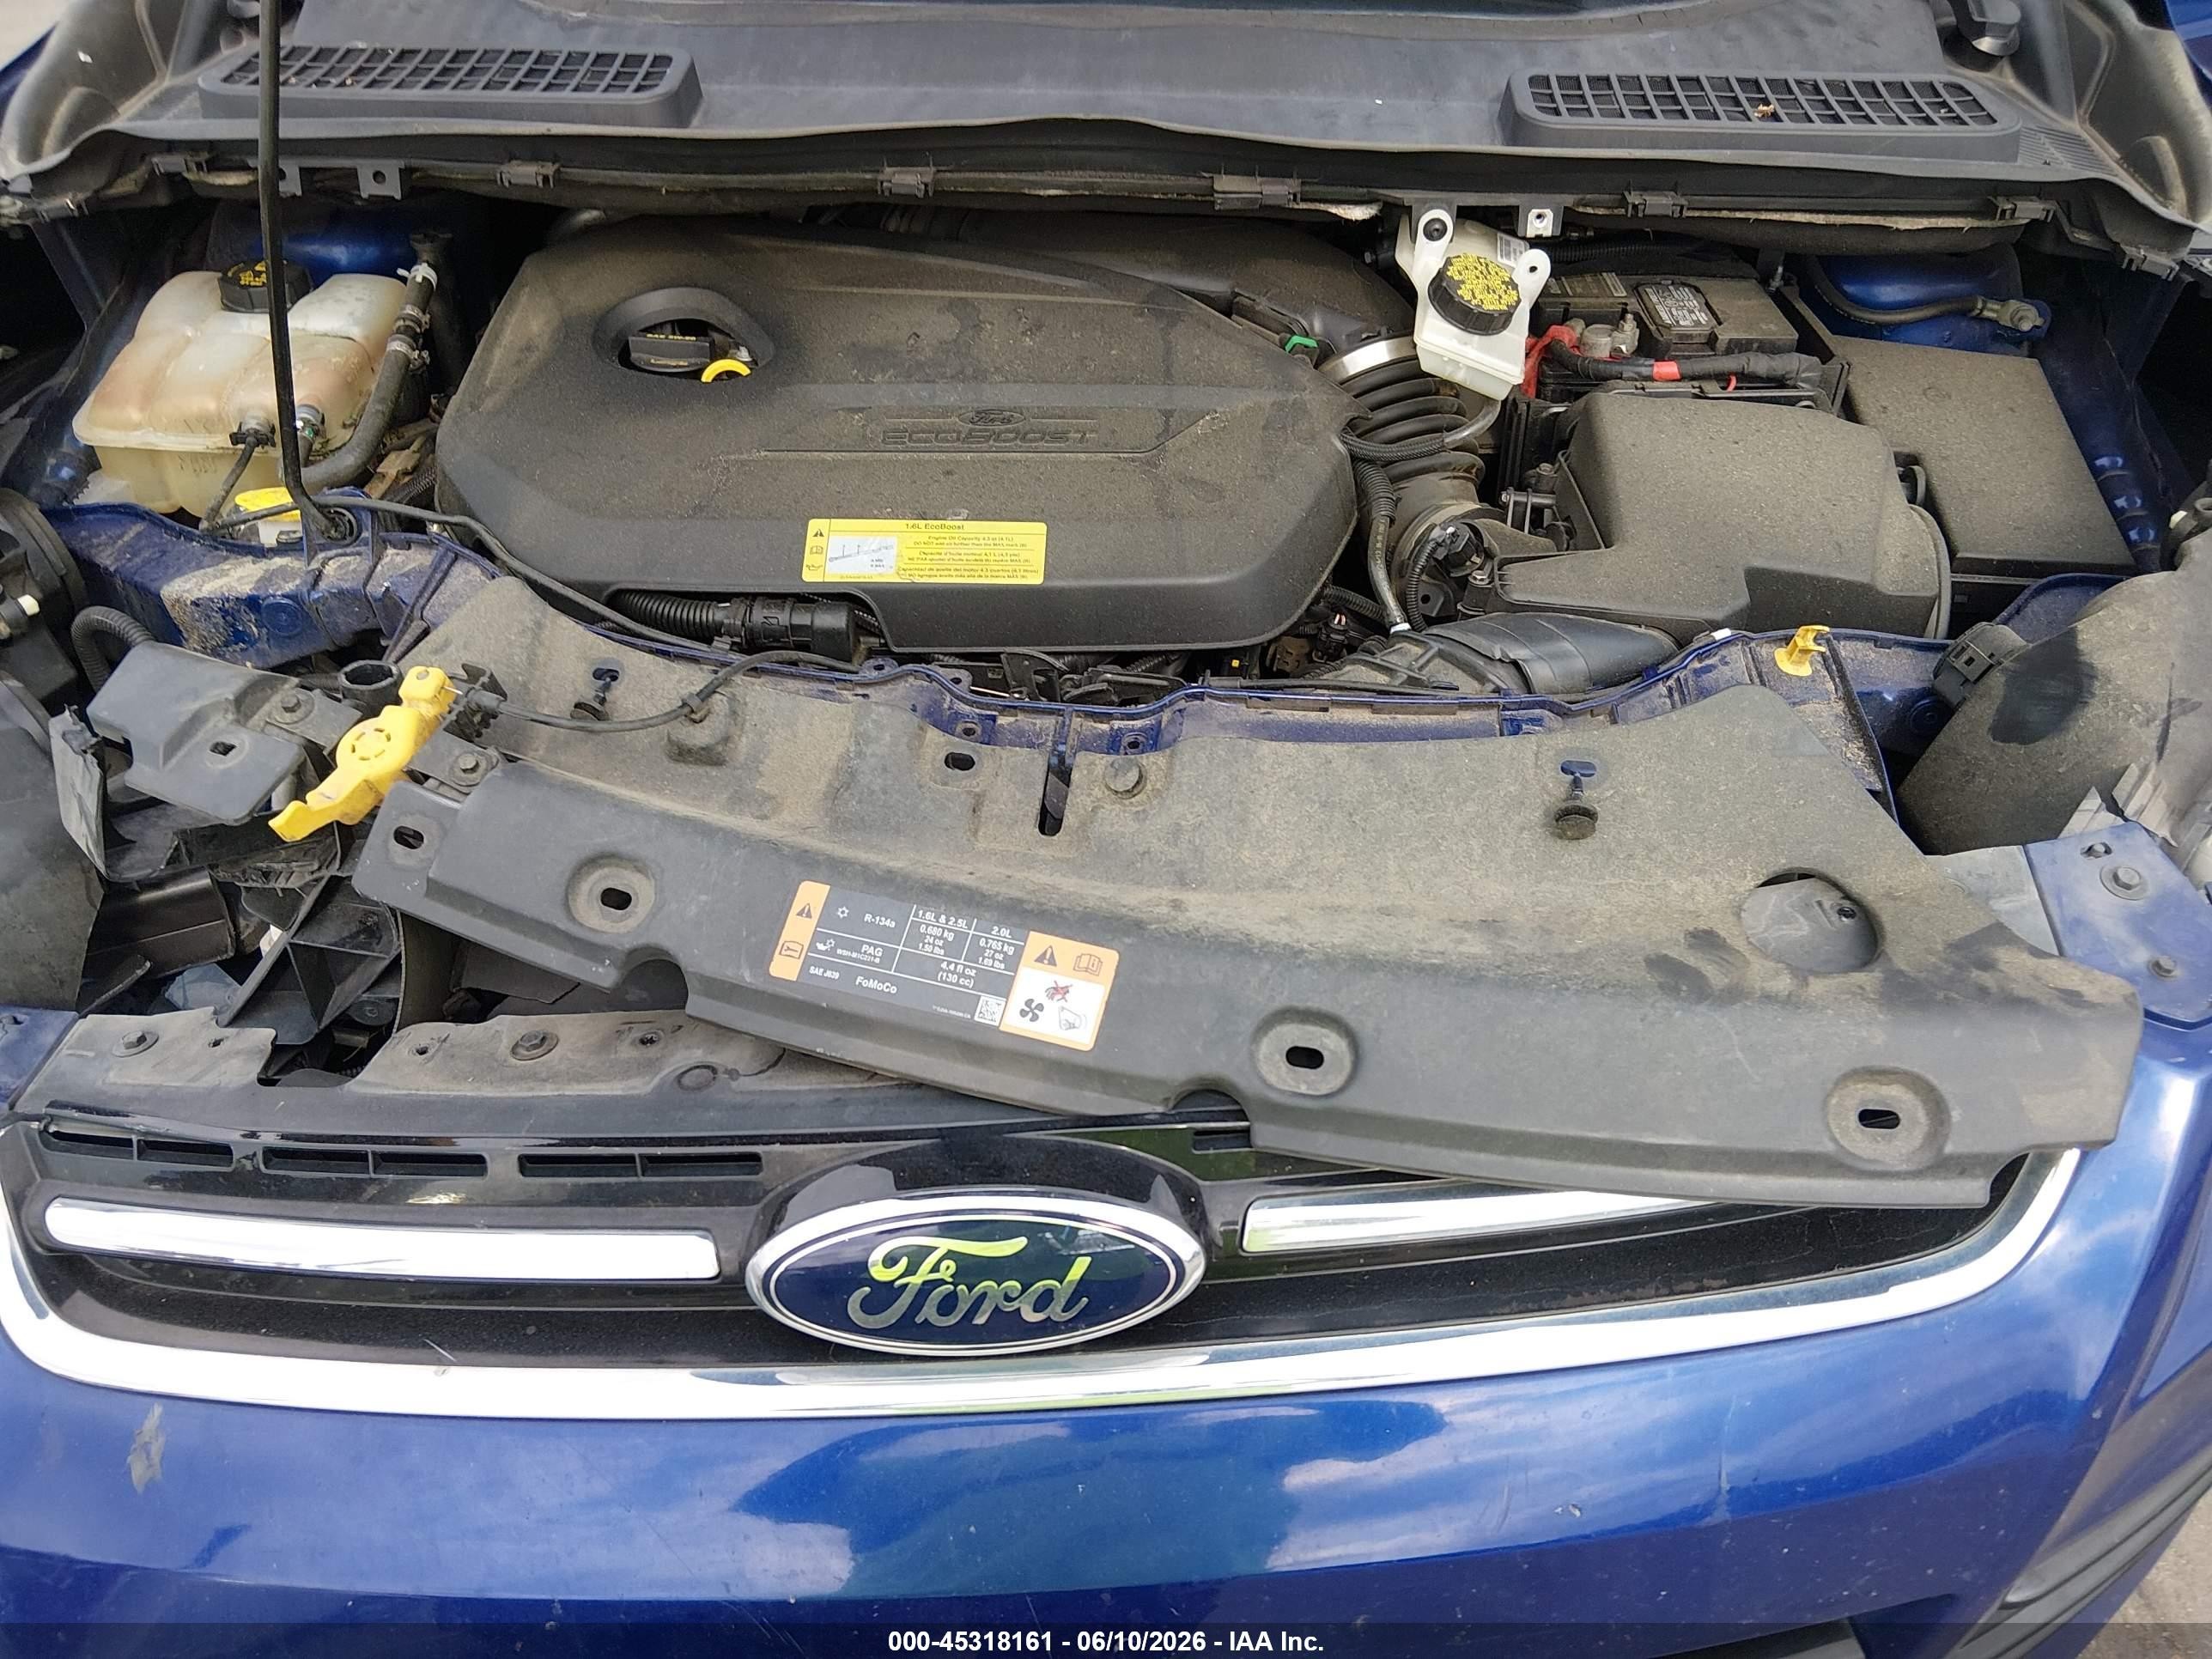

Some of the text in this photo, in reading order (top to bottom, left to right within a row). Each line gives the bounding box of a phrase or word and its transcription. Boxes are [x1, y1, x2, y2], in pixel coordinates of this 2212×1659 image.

[881, 428, 1097, 446] ECOBOOST
[864, 913, 896, 928] R-134a
[917, 909, 969, 929] 1.6L & 2.5L
[920, 924, 955, 941] 0.680 kg
[991, 926, 1012, 938] 2.0L
[860, 944, 884, 957] PAG
[933, 946, 945, 955] lbs
[979, 938, 1015, 955] 0.765 kg
[984, 949, 994, 957] 27
[809, 966, 823, 976] SAE
[940, 961, 977, 976] 4.4 fl oz
[994, 960, 1006, 969] lbs
[855, 975, 897, 994] FoMoCo
[938, 971, 975, 988] (130 cc)
[848, 1237, 1091, 1329] Ford
